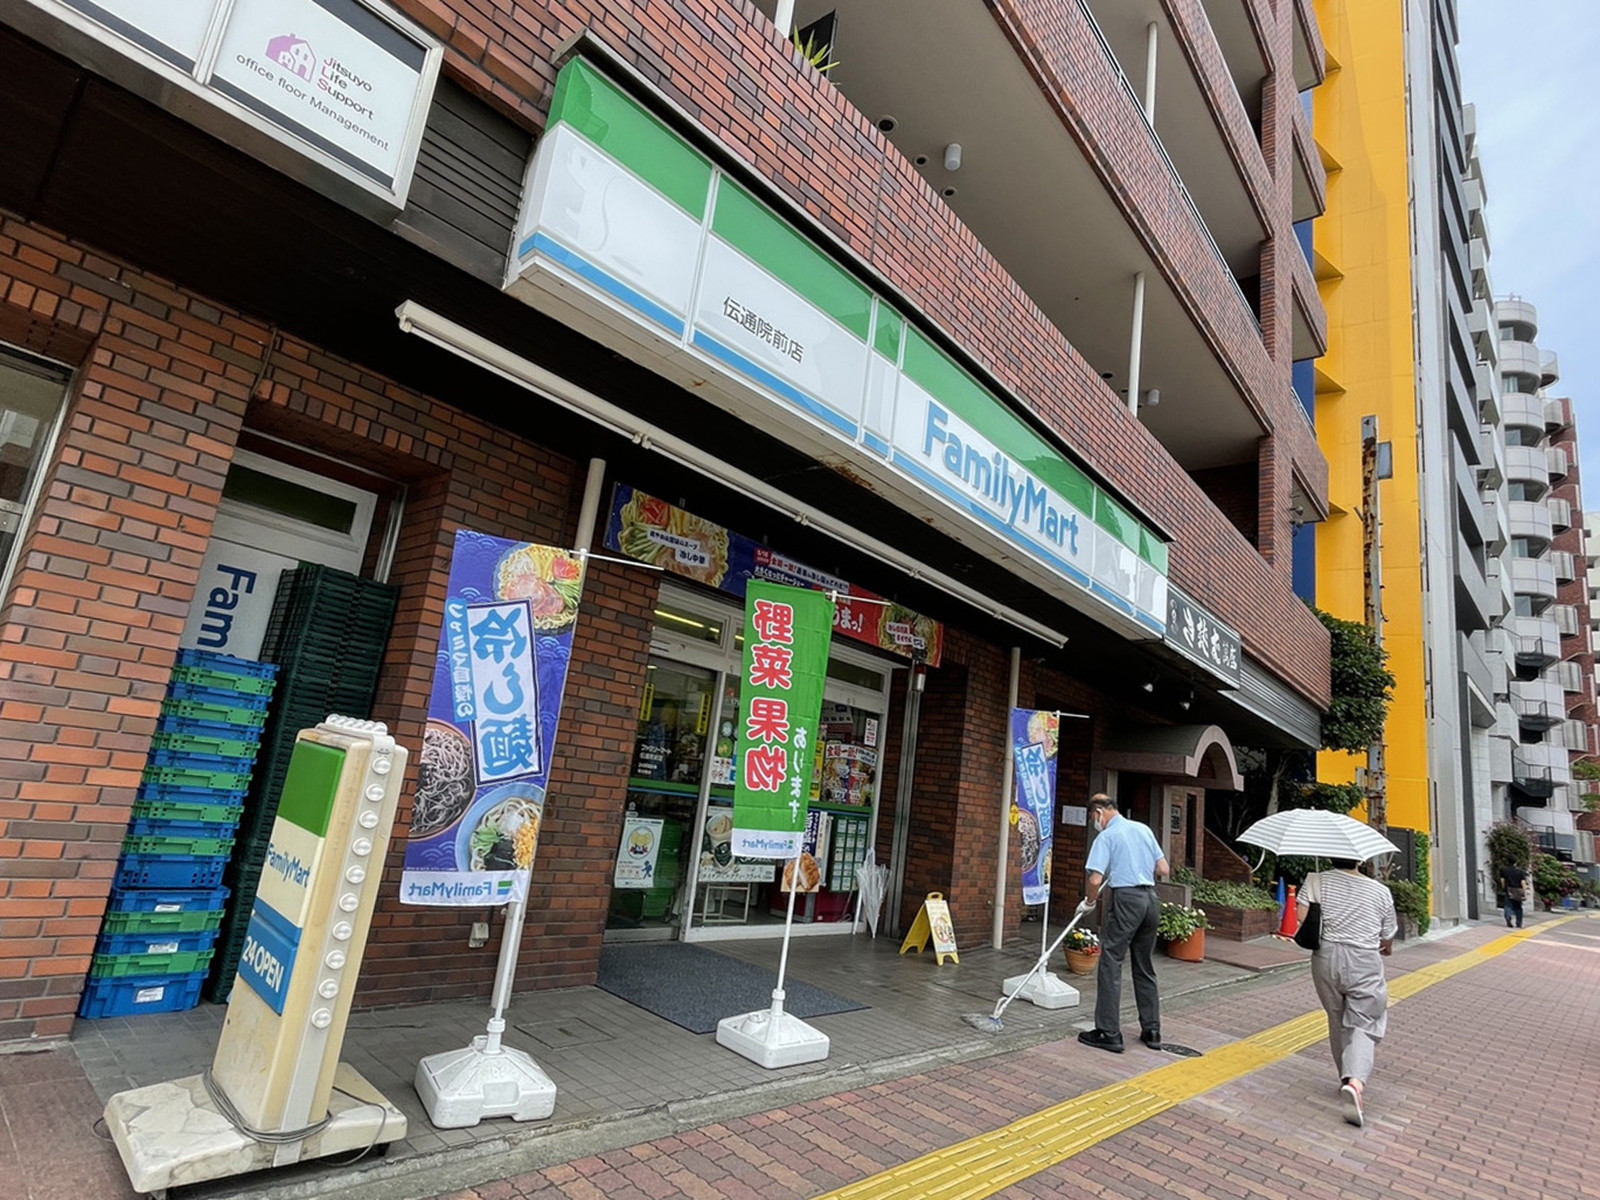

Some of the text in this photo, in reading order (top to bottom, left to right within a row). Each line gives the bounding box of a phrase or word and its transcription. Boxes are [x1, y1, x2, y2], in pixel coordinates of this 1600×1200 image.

[236, 54, 390, 151] office floor Management
[316, 77, 375, 121] Support
[321, 64, 348, 90] Life
[323, 56, 373, 92] Jitsuyo
[723, 296, 804, 364] 伝通院前店
[922, 400, 1080, 555] FamilyMart
[201, 563, 257, 656] Fam
